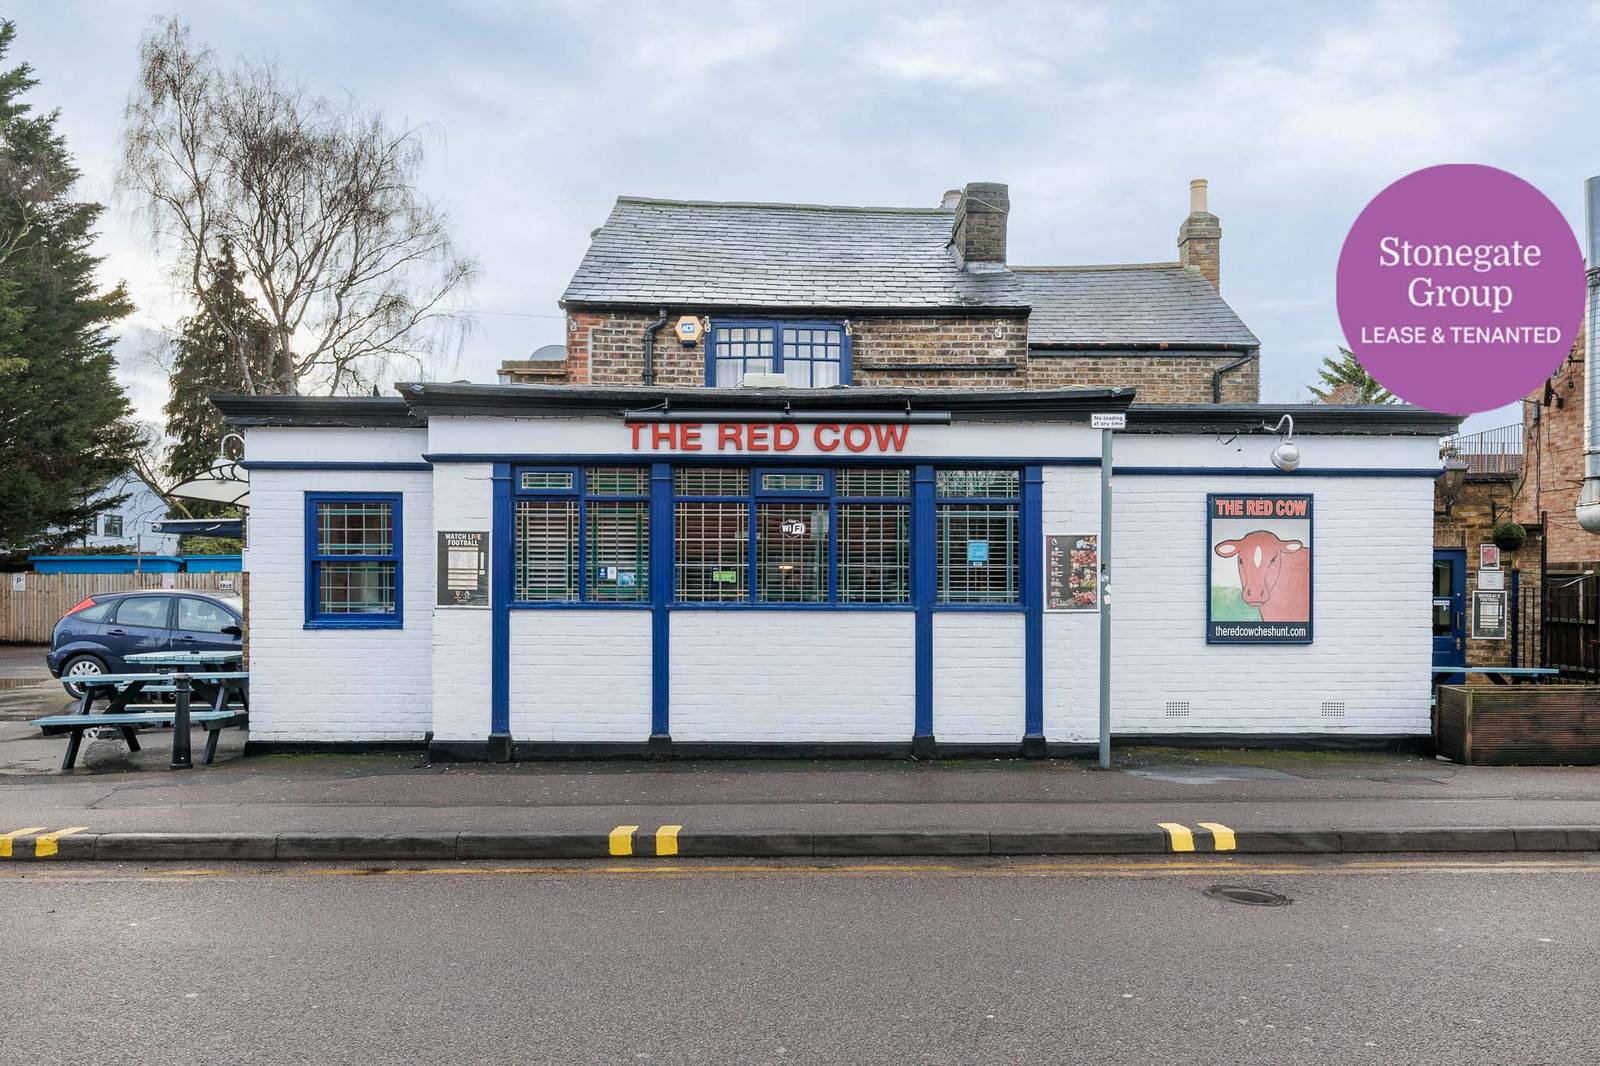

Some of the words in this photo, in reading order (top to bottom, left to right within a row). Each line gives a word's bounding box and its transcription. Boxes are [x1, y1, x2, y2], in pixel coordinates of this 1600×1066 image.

[624, 423, 703, 451] THE
[718, 423, 800, 452] RED
[814, 424, 911, 453] COW
[1215, 499, 1244, 516] THE
[1246, 498, 1274, 516] RED
[1276, 499, 1307, 516] COW
[1215, 625, 1306, 637] theredcowcheshunt.com
